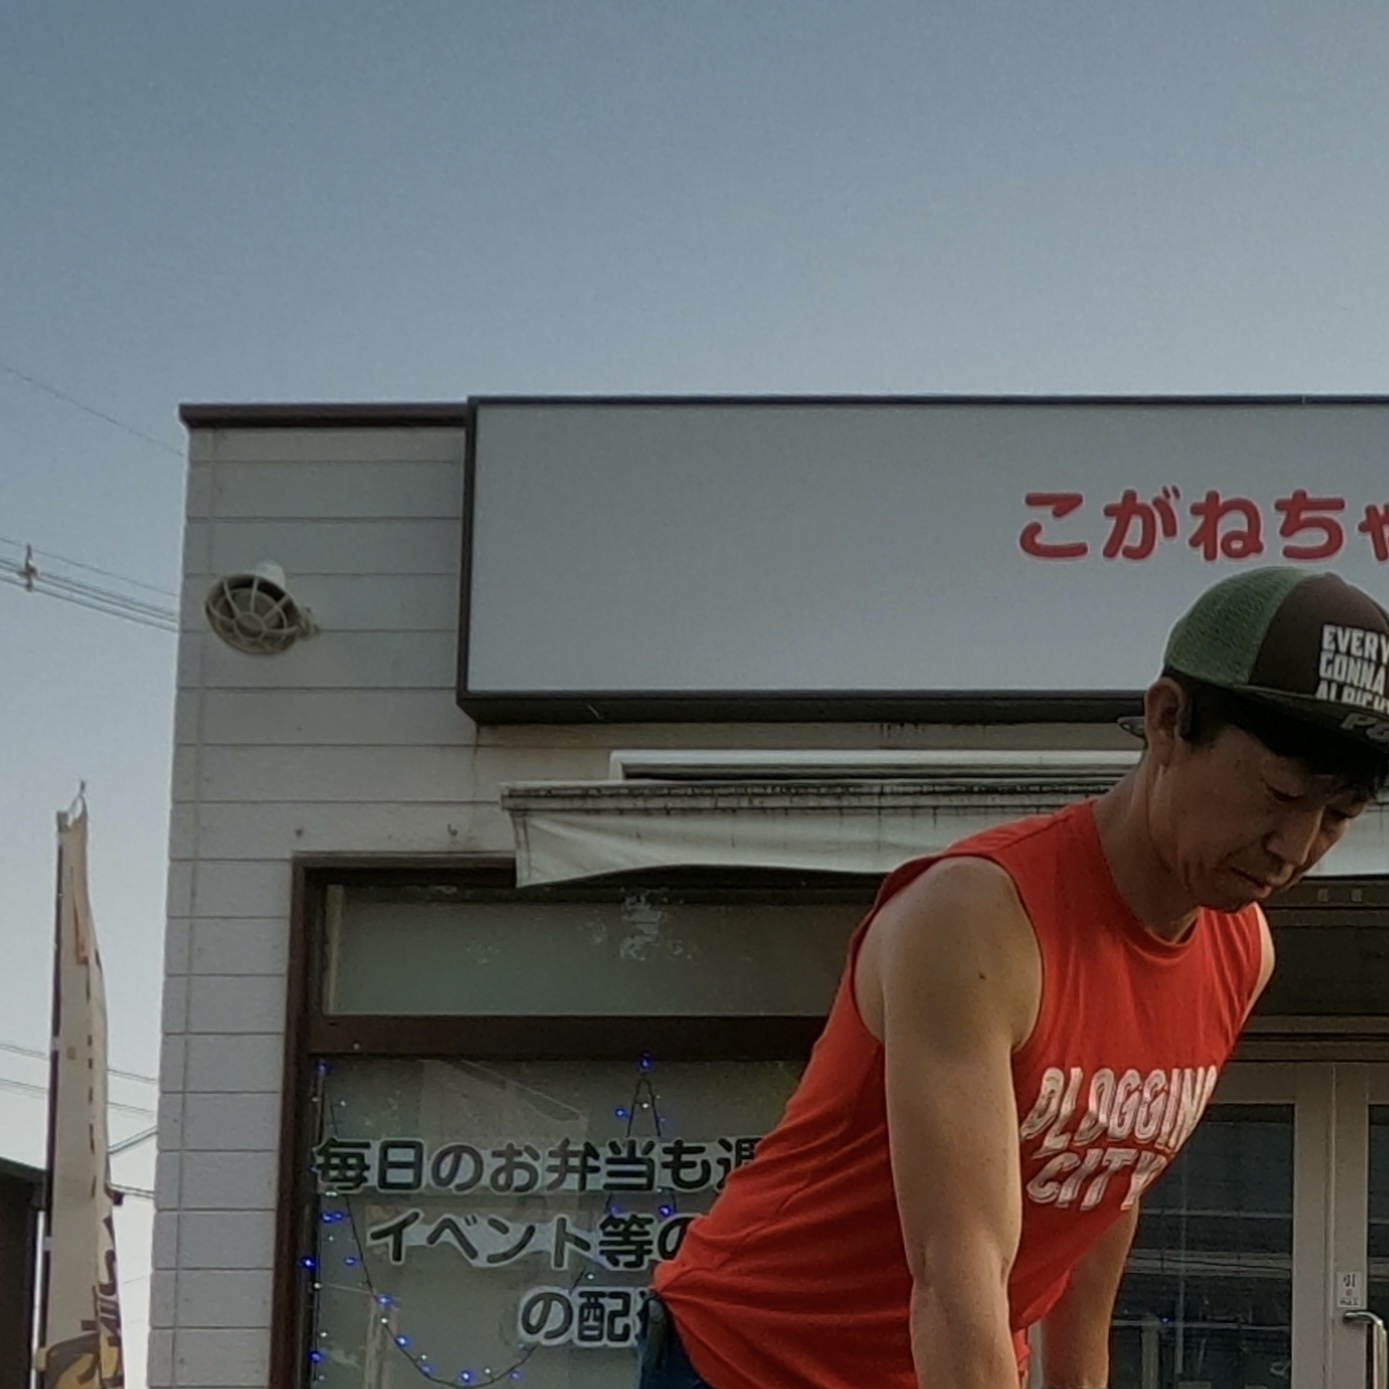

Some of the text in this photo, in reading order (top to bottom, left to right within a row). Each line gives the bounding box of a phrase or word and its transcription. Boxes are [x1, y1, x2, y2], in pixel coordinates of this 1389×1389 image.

[1318, 650, 1386, 696] GONNA
[1026, 1147, 1168, 1211] CITY
[520, 1290, 668, 1344] の配
